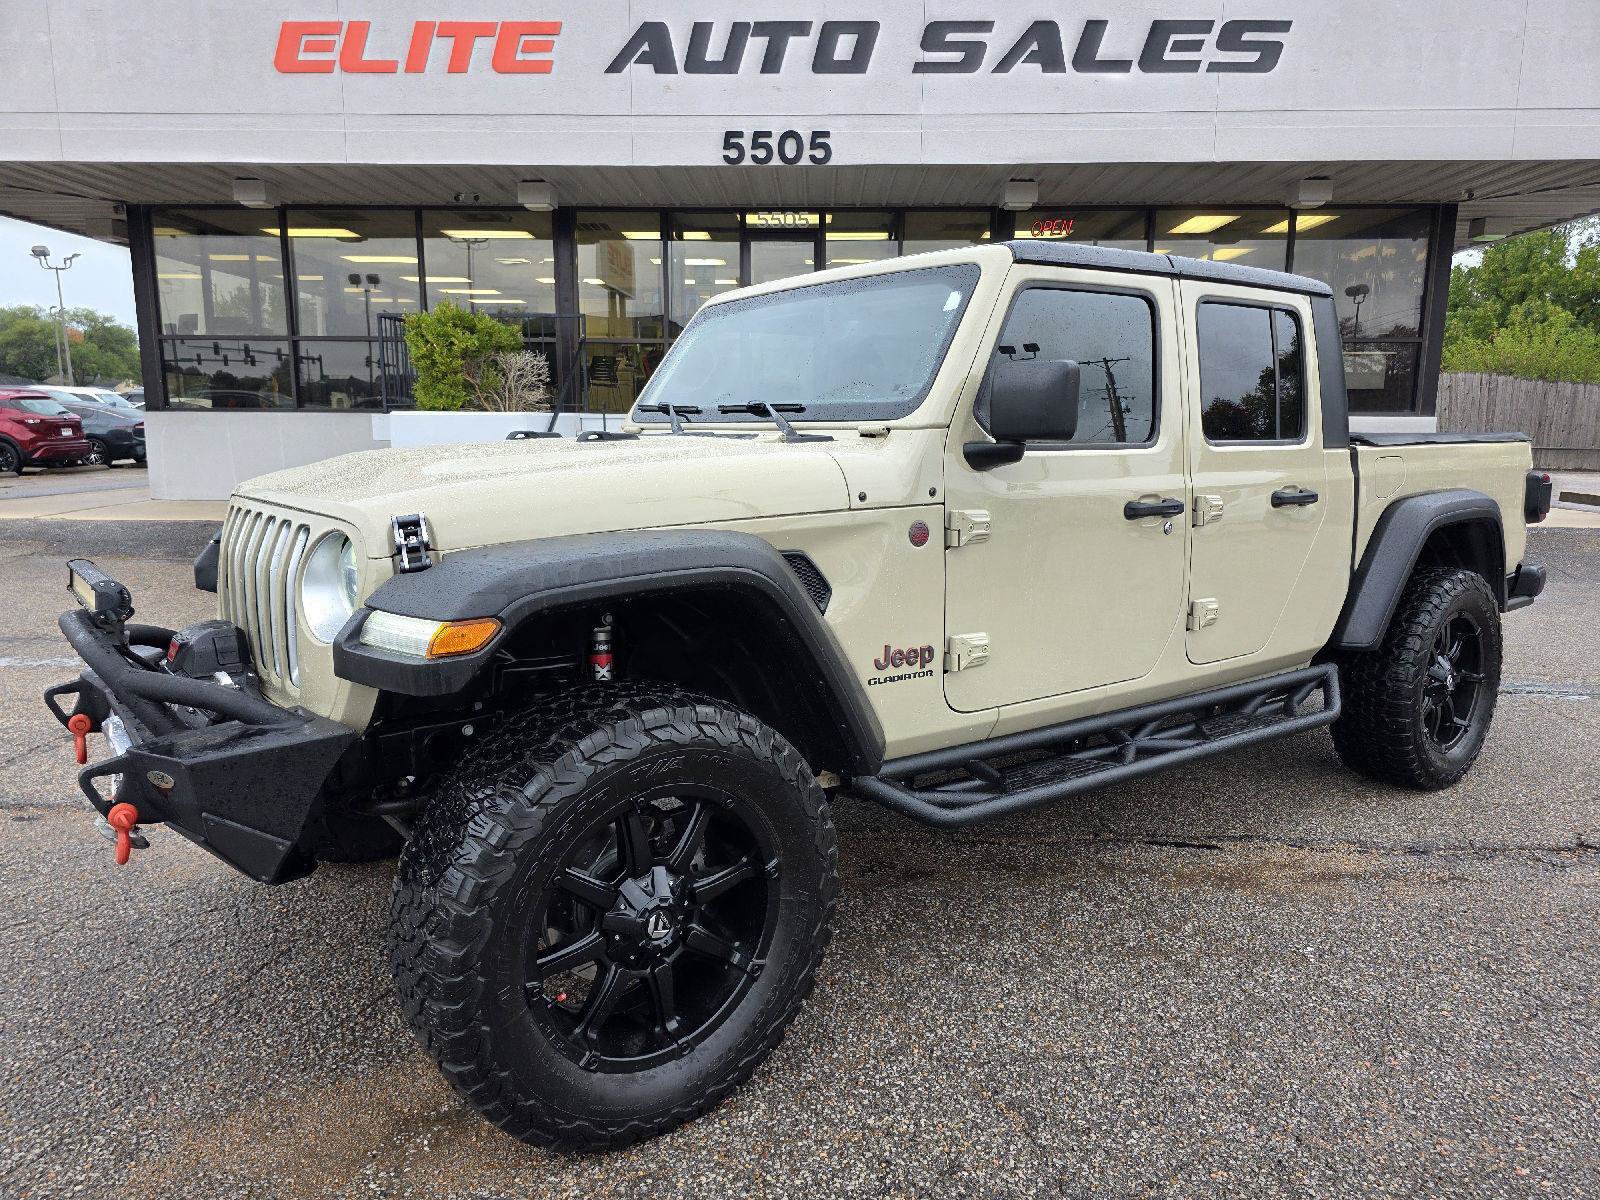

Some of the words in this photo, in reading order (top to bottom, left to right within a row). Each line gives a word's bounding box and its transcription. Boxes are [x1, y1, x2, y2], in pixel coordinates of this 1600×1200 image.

[273, 20, 563, 74] ELITE
[604, 20, 881, 74] AUTO
[911, 19, 1294, 74] SALES
[722, 130, 833, 165] 5505
[757, 211, 810, 229] 5505
[1030, 219, 1074, 238] OPEN
[873, 644, 935, 671] Jeep
[867, 669, 934, 687] GLADIATOR
